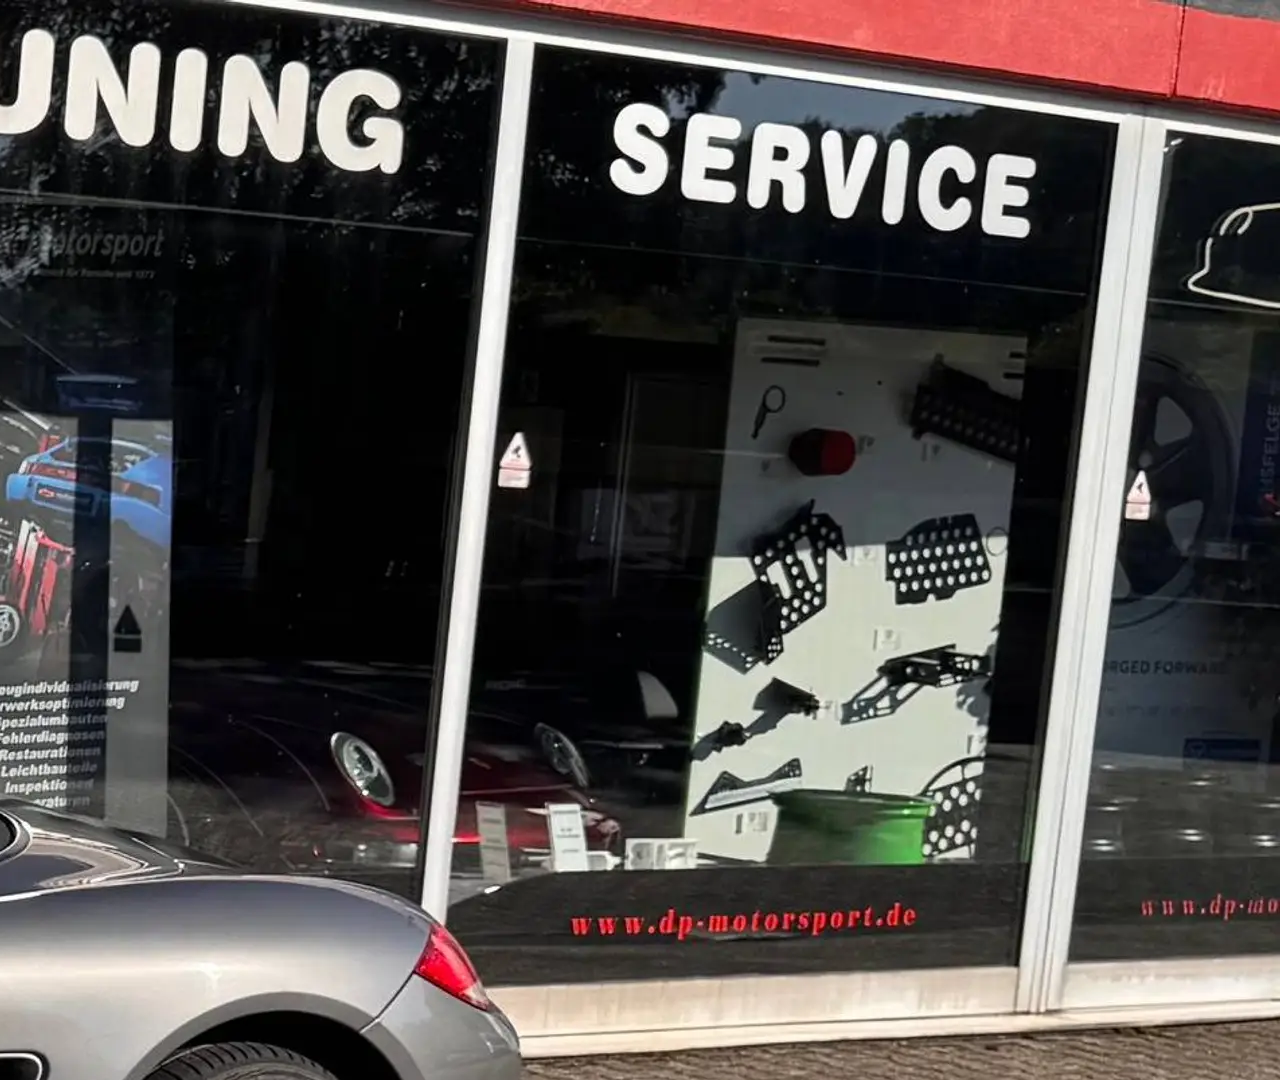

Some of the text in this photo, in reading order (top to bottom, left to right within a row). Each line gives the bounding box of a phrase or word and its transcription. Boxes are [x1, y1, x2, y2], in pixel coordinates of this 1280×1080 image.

[609, 103, 1037, 240] SERVICE
[27, 227, 165, 265] otorsport
[0, 762, 98, 778] Leichtbauteile
[4, 779, 95, 795] Inspektionen
[570, 902, 917, 942] www.dp-motorsport.de
